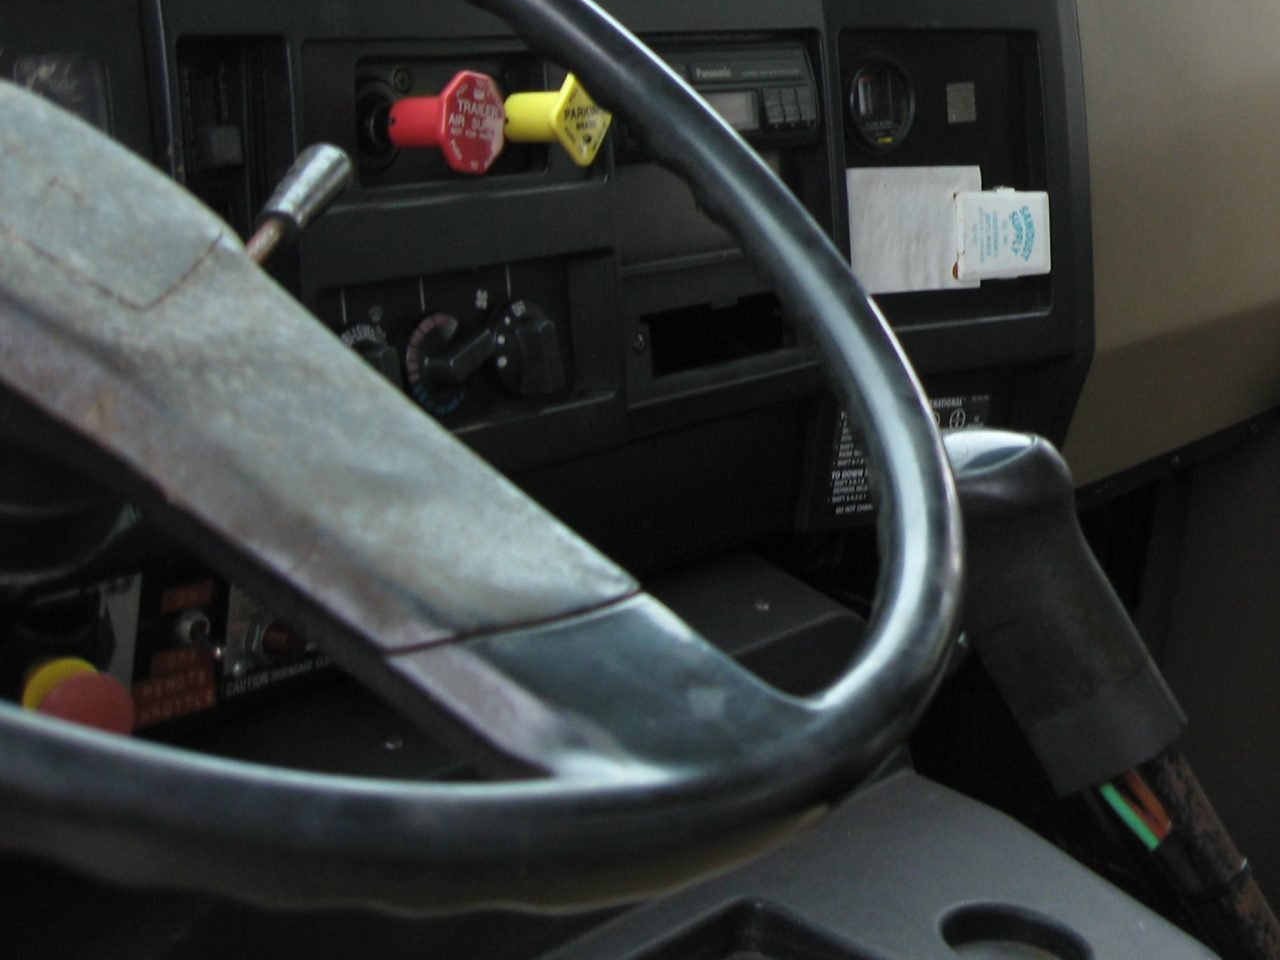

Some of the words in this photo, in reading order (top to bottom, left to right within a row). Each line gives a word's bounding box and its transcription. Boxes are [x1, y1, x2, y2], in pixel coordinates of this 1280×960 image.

[458, 100, 498, 119] TRAILER
[448, 113, 465, 127] AIR
[1009, 211, 1023, 256] SUPPLY
[930, 395, 963, 409] NATIONAL
[832, 471, 841, 480] TO
[842, 469, 864, 479] DOWN
[140, 689, 214, 721] HROTTLE
